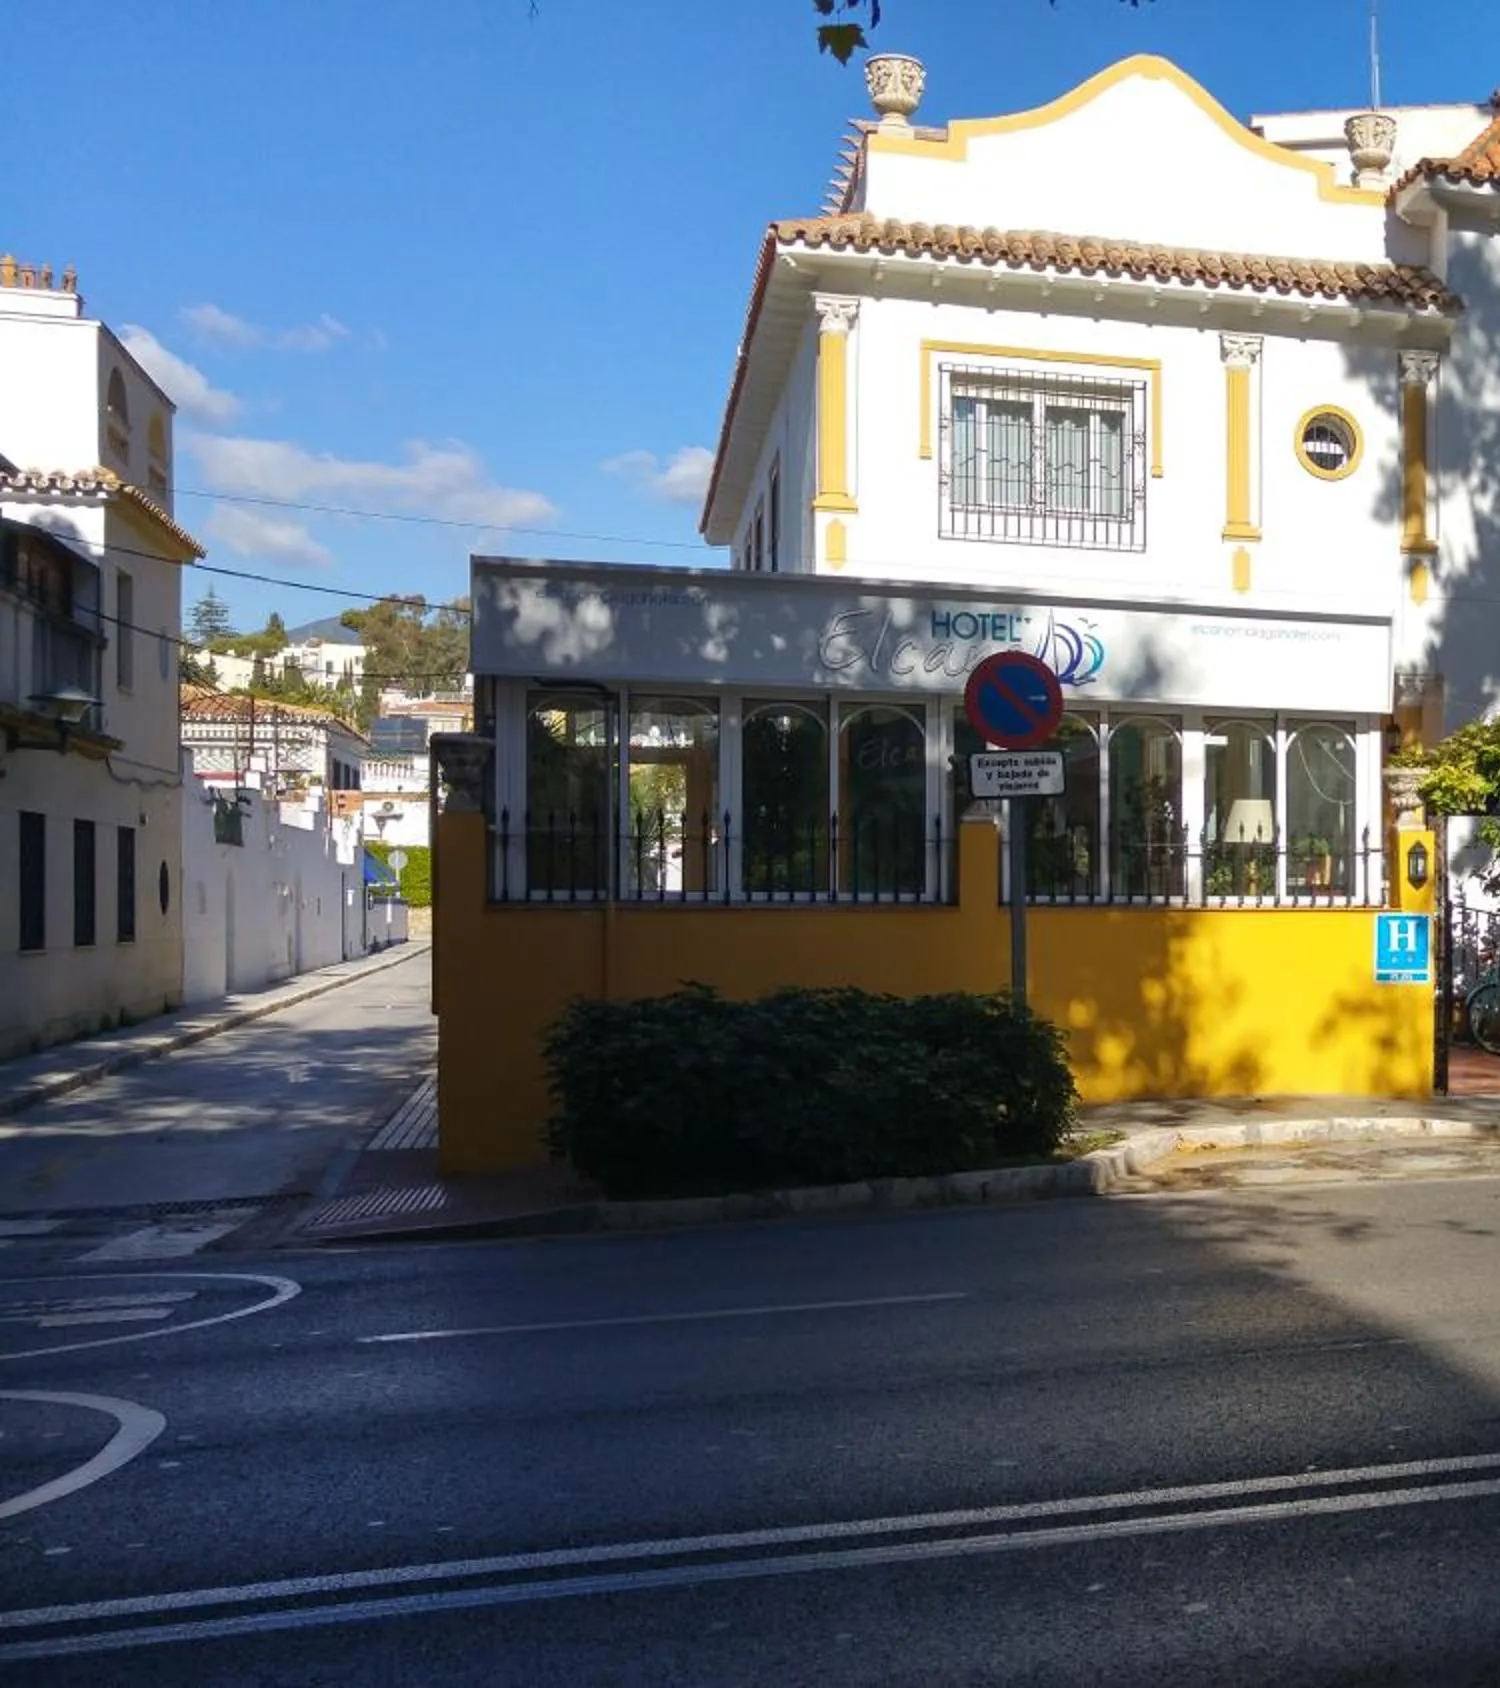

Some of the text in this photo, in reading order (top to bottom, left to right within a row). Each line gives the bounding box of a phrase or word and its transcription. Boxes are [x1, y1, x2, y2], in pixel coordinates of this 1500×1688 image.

[931, 610, 1022, 642] HOTEL
[985, 771, 993, 780] y
[1388, 920, 1417, 952] H
